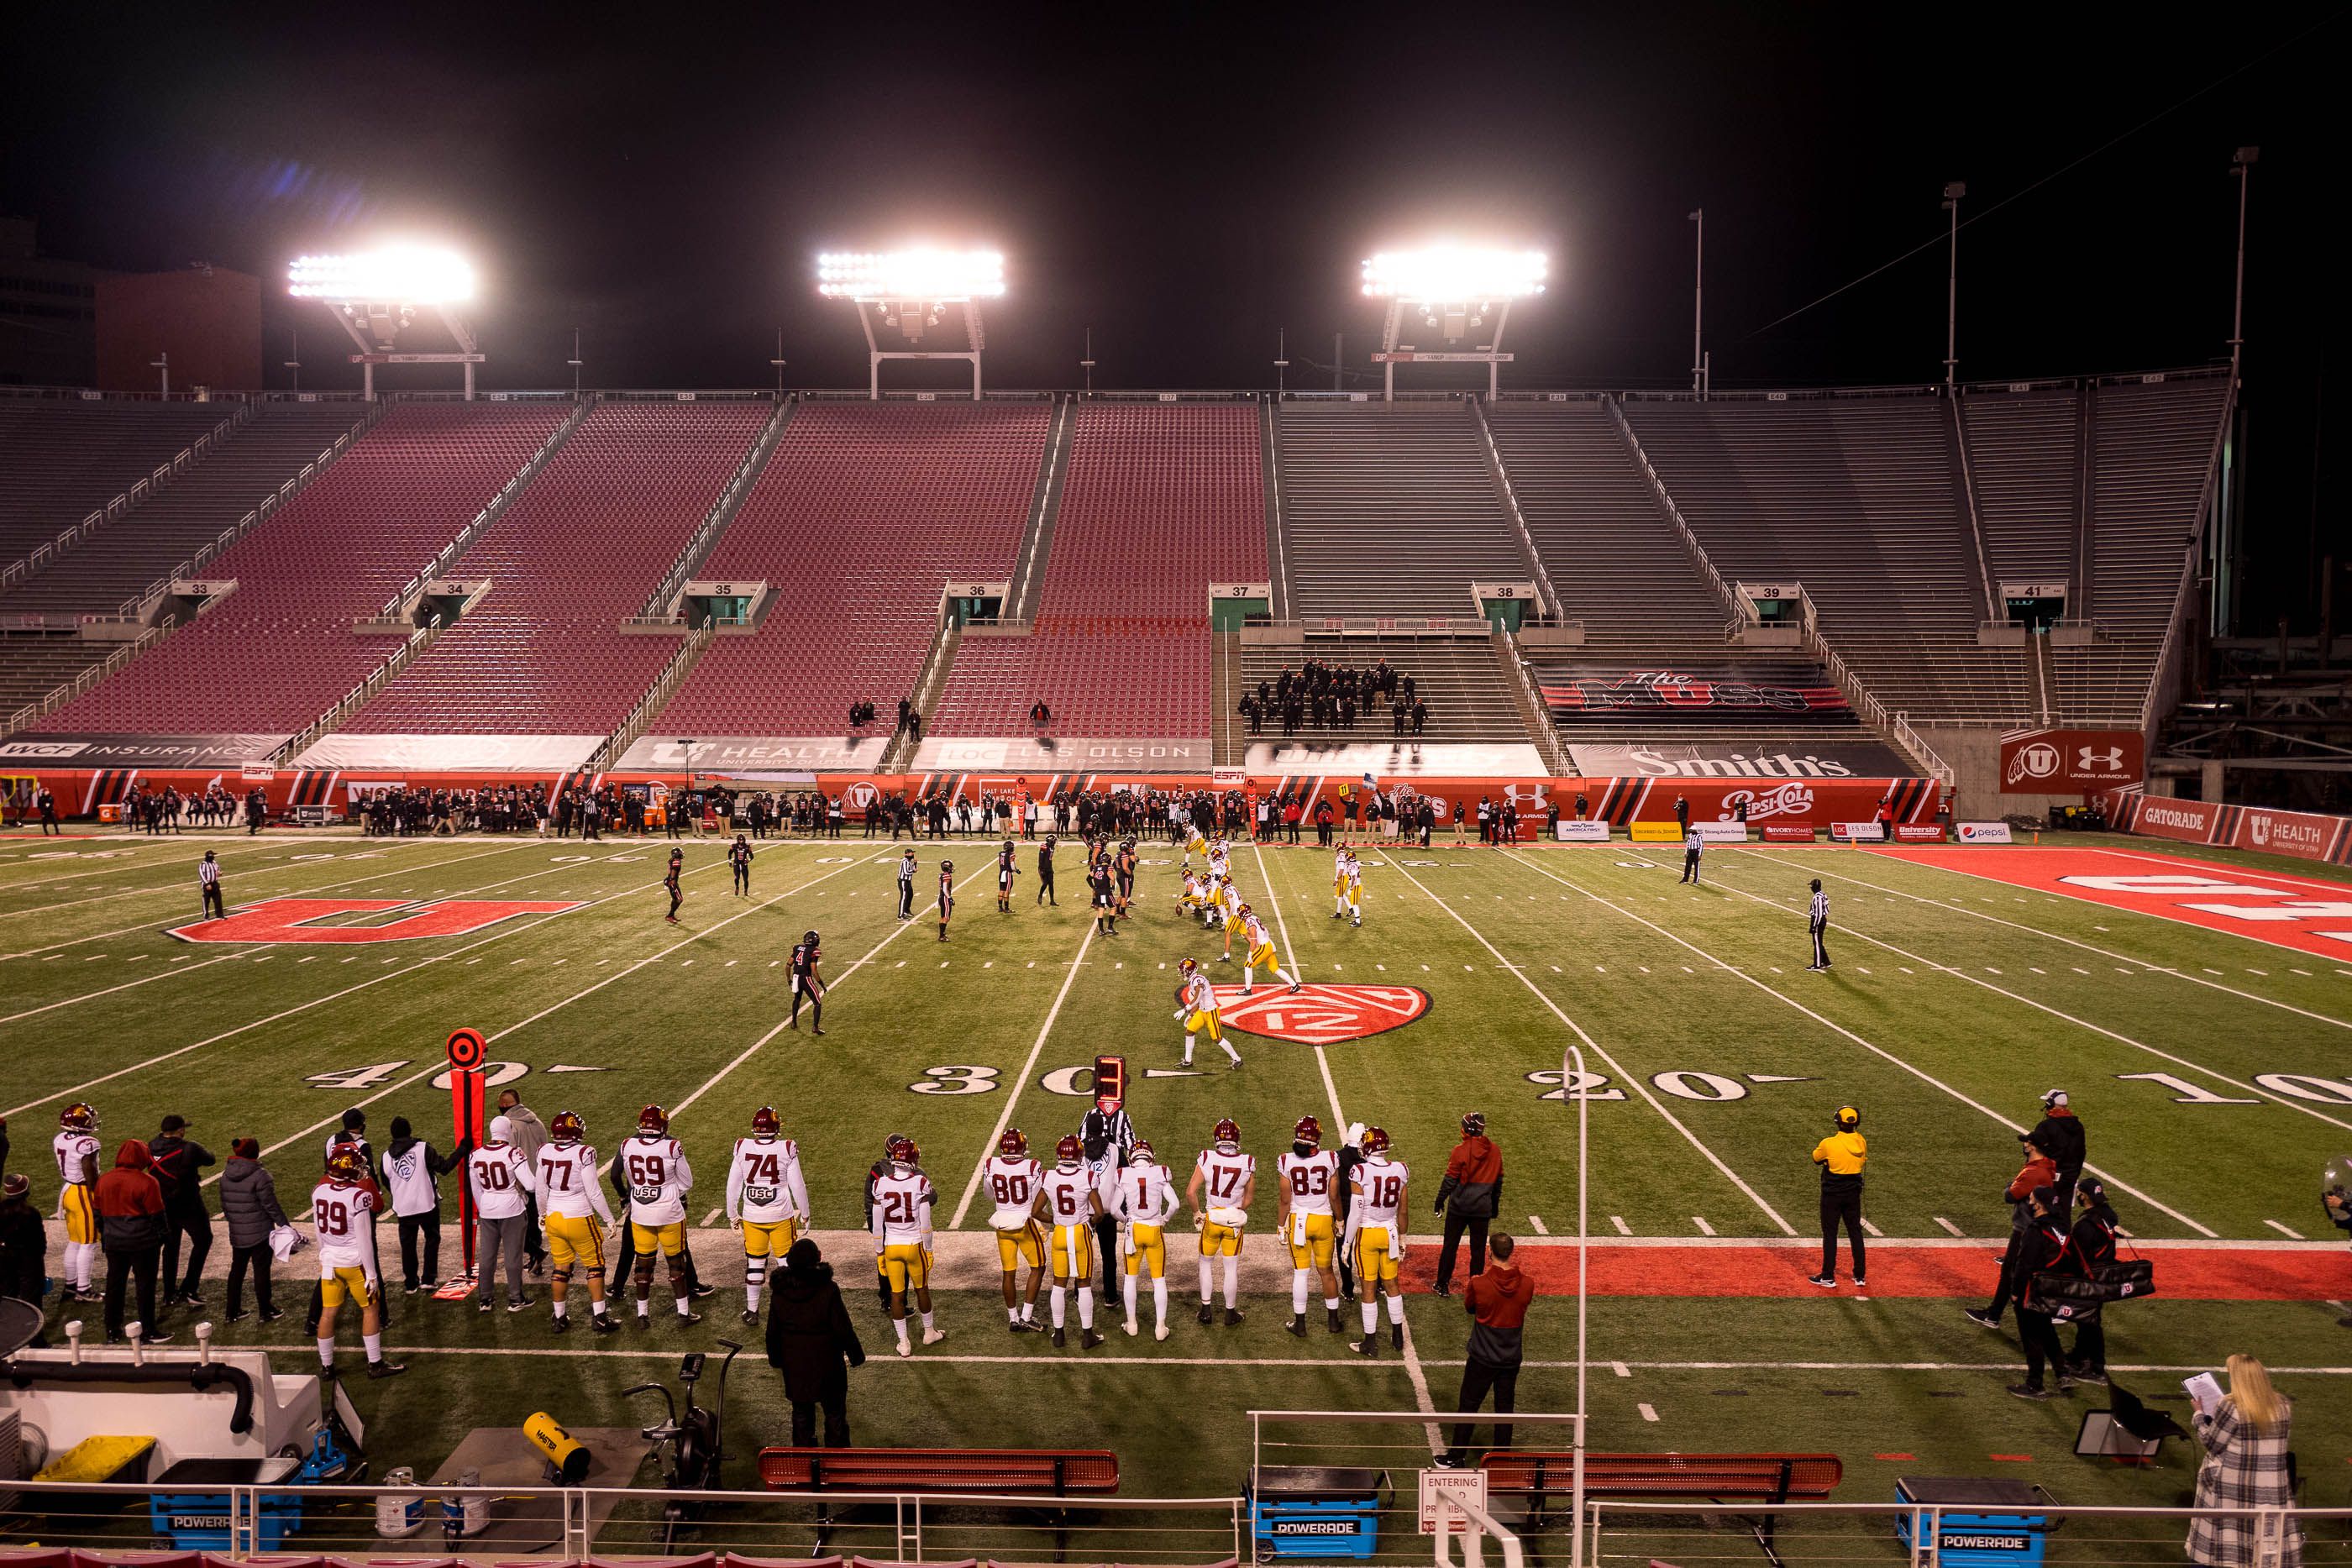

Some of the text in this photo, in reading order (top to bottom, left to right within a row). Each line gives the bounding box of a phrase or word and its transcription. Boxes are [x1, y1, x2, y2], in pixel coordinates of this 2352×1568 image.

[192, 584, 207, 594] 33
[448, 584, 463, 594] 34
[716, 585, 732, 595] 35
[969, 585, 984, 595] 36
[1232, 587, 1248, 596] 37
[1498, 587, 1513, 597] 38
[1763, 588, 1779, 597] 39
[2024, 586, 2040, 597] 41
[1575, 680, 1811, 711] MUSS
[4, 745, 265, 756] WCF INSURANCE
[720, 747, 861, 759] HEALTH
[947, 749, 998, 760] LOC
[1020, 747, 1189, 758] LES OLSON
[1629, 751, 1852, 776] Smith's
[2028, 750, 2053, 774] U
[244, 767, 274, 776] ESPN
[1214, 770, 1245, 779] ESPN
[2145, 807, 2204, 831] GATORADE
[1898, 826, 1941, 835] University
[1977, 826, 2007, 837] pepsi
[2273, 824, 2320, 842] HEALTH
[2273, 842, 2299, 850] UNIVERSITY
[2307, 845, 2319, 853] UTAH
[795, 951, 804, 966] 4
[1266, 1012, 1365, 1030] 12
[1100, 1059, 1121, 1101] 3
[58, 1148, 68, 1177] 7
[1093, 1163, 1103, 1172] 12
[399, 1166, 411, 1177] 12
[540, 1158, 573, 1191] 77
[628, 1155, 666, 1187] 69
[744, 1152, 780, 1186] 74
[474, 1161, 510, 1190] 30
[1210, 1165, 1243, 1198] 17
[1289, 1165, 1328, 1196] 83
[634, 1188, 658, 1198] USC
[750, 1188, 774, 1198] USC
[991, 1174, 1029, 1205] 80
[1137, 1177, 1148, 1210] 1
[1373, 1175, 1400, 1209] 18
[1056, 1184, 1075, 1215] 6
[885, 1191, 916, 1224] 21
[316, 1198, 348, 1235] 89
[536, 1429, 557, 1451] MASTER
[1428, 1478, 1478, 1487] ENTERING
[1278, 1523, 1354, 1534] POWERADE
[1944, 1535, 2024, 1548] POWERADE
